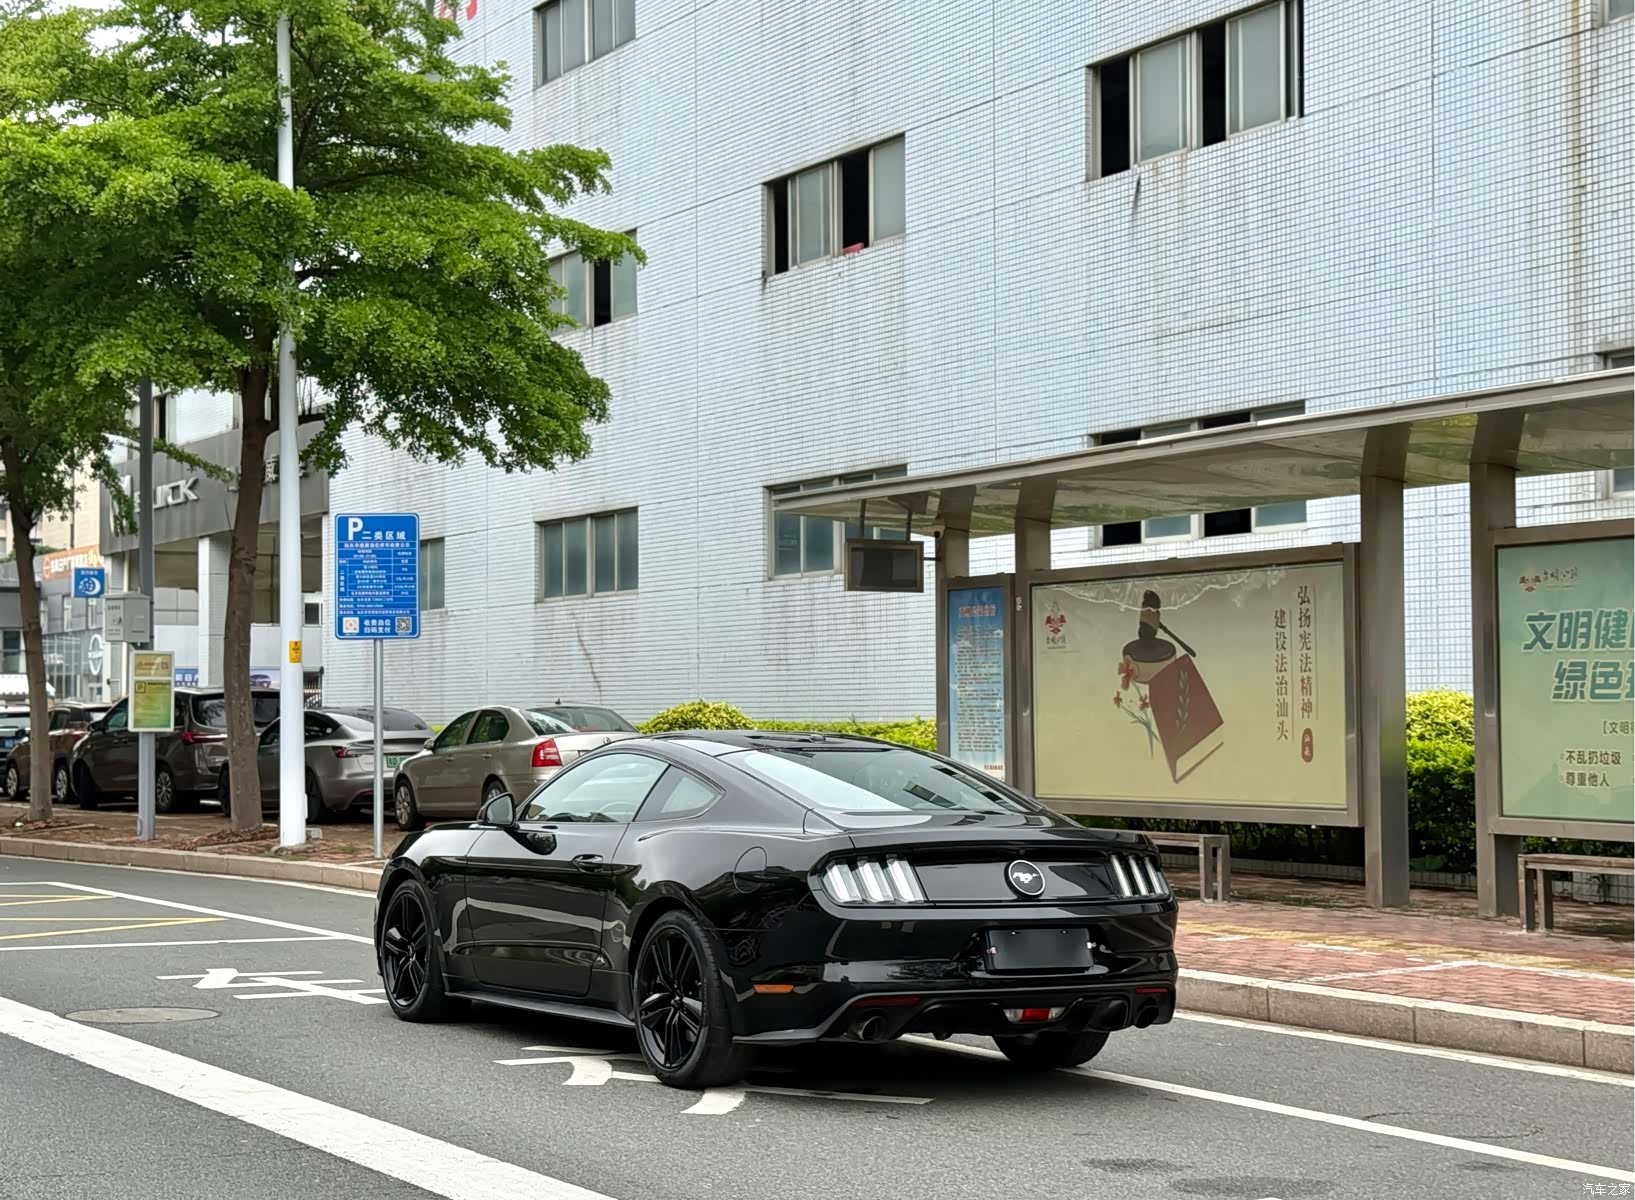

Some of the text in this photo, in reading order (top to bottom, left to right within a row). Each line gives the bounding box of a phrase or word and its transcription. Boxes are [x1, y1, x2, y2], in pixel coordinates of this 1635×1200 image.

[348, 517, 407, 541] P 二类区域
[1522, 609, 1634, 651] 文明健
[1297, 585, 1313, 720] 弘扬宪法精神
[1273, 608, 1289, 741] 建设法治汕头
[1551, 659, 1634, 701] 绿色
[1565, 750, 1622, 766] 不乱扔垃圾
[1565, 771, 1610, 787] 尊重他人
